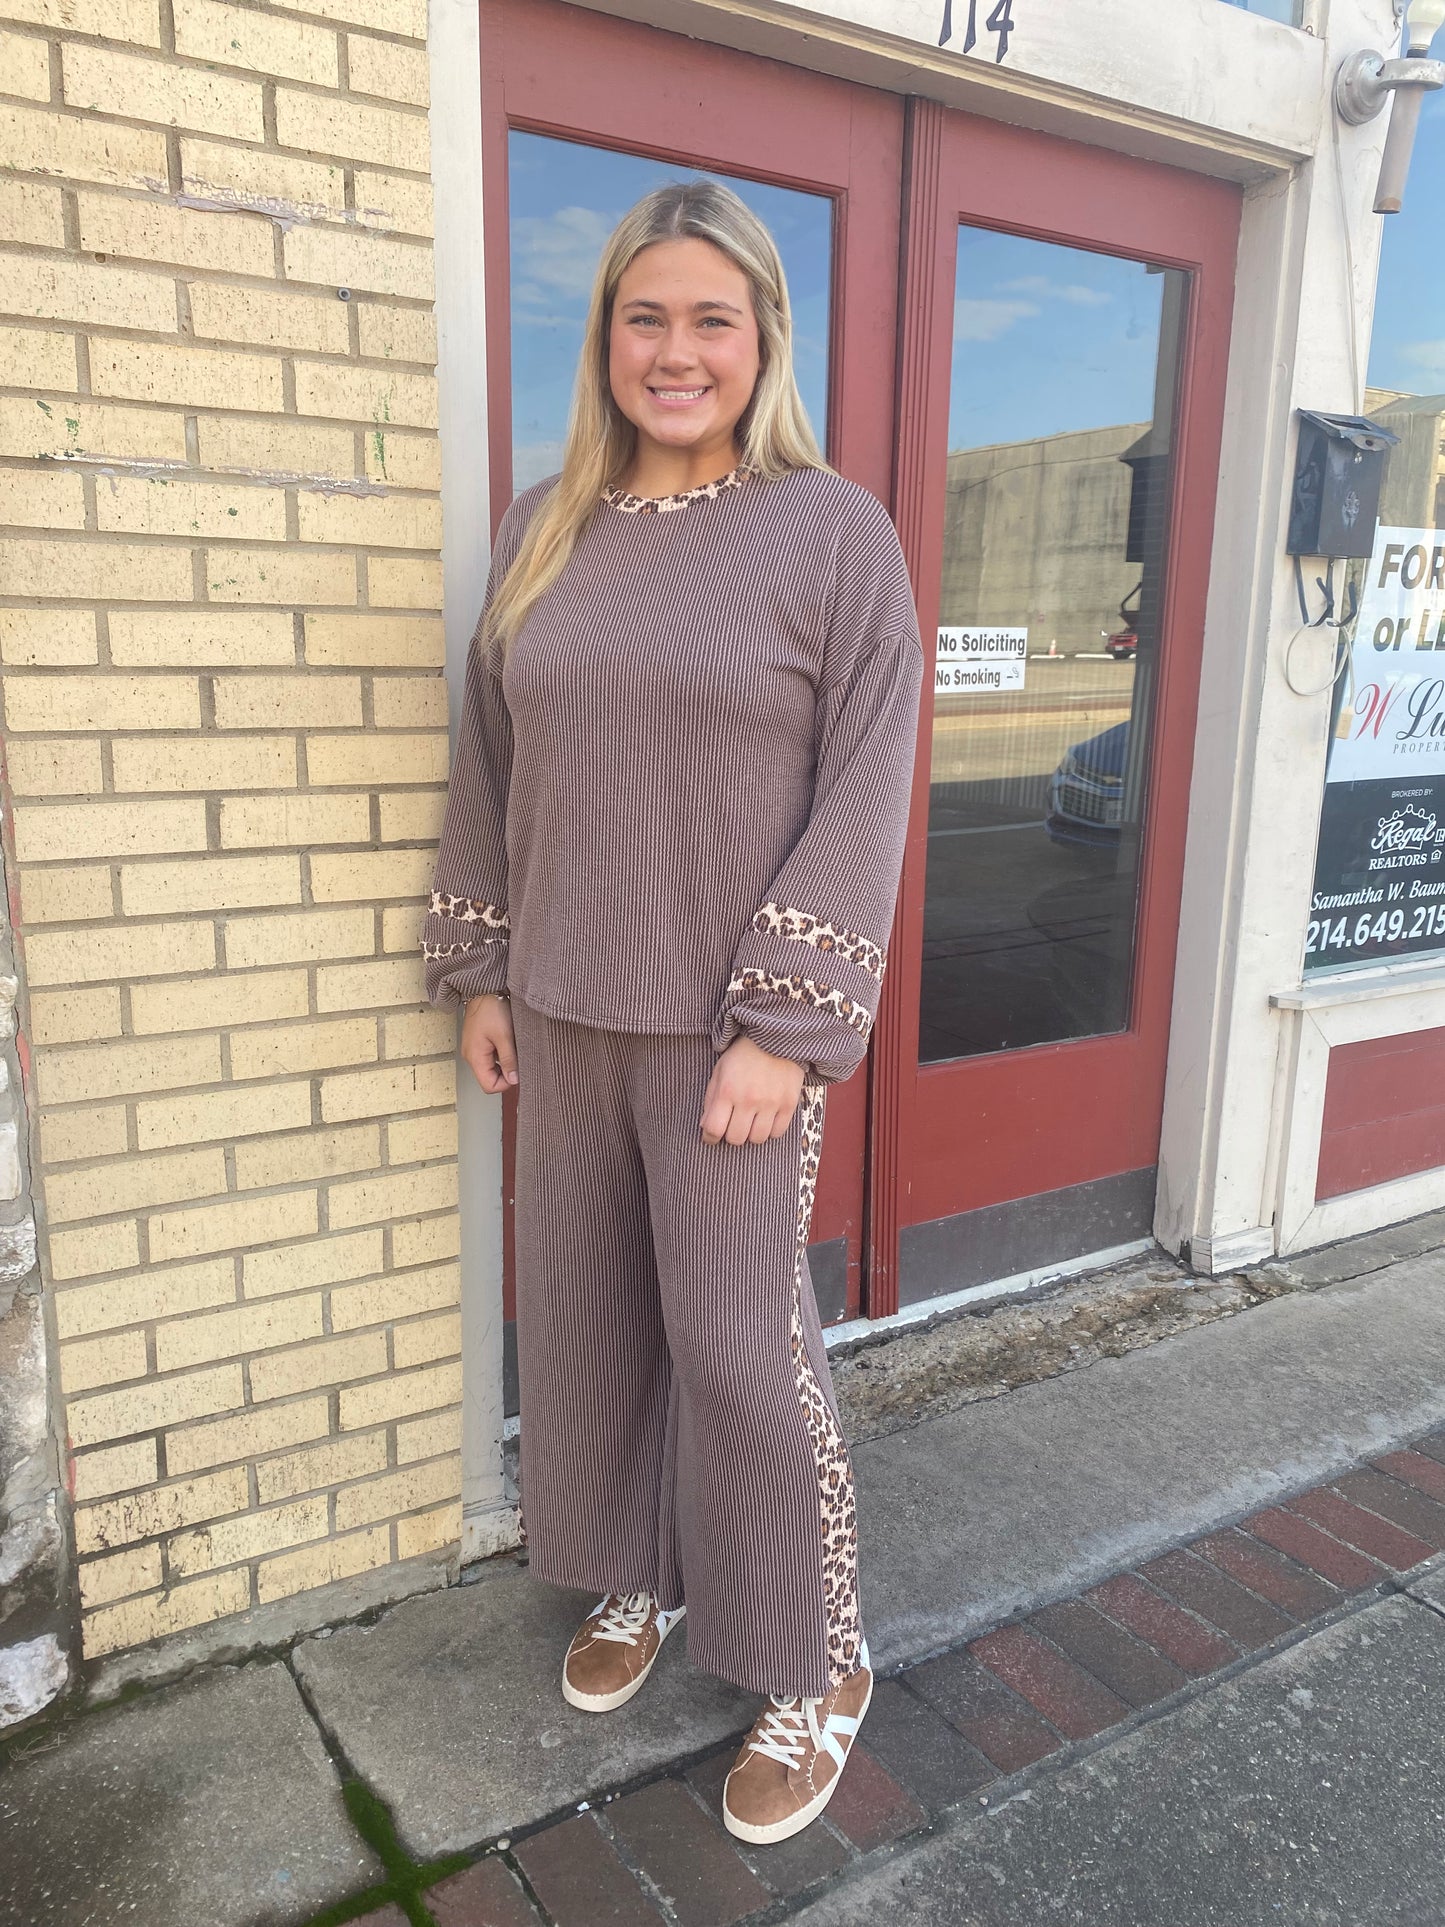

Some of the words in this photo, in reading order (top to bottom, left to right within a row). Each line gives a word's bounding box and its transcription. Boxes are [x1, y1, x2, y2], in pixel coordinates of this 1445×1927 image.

[938, 0, 1015, 64] 114
[1377, 543, 1445, 590] FOR
[938, 633, 957, 652] No
[961, 633, 1026, 656] Soliciting
[1373, 617, 1411, 652] or
[936, 669, 951, 687] No
[954, 668, 1001, 688] Smoking
[1391, 789, 1424, 799] BROKERED
[1371, 820, 1437, 851] Regal
[1368, 853, 1428, 871] REALTORS
[1310, 886, 1385, 912] Samantha
[1387, 881, 1405, 902] W.
